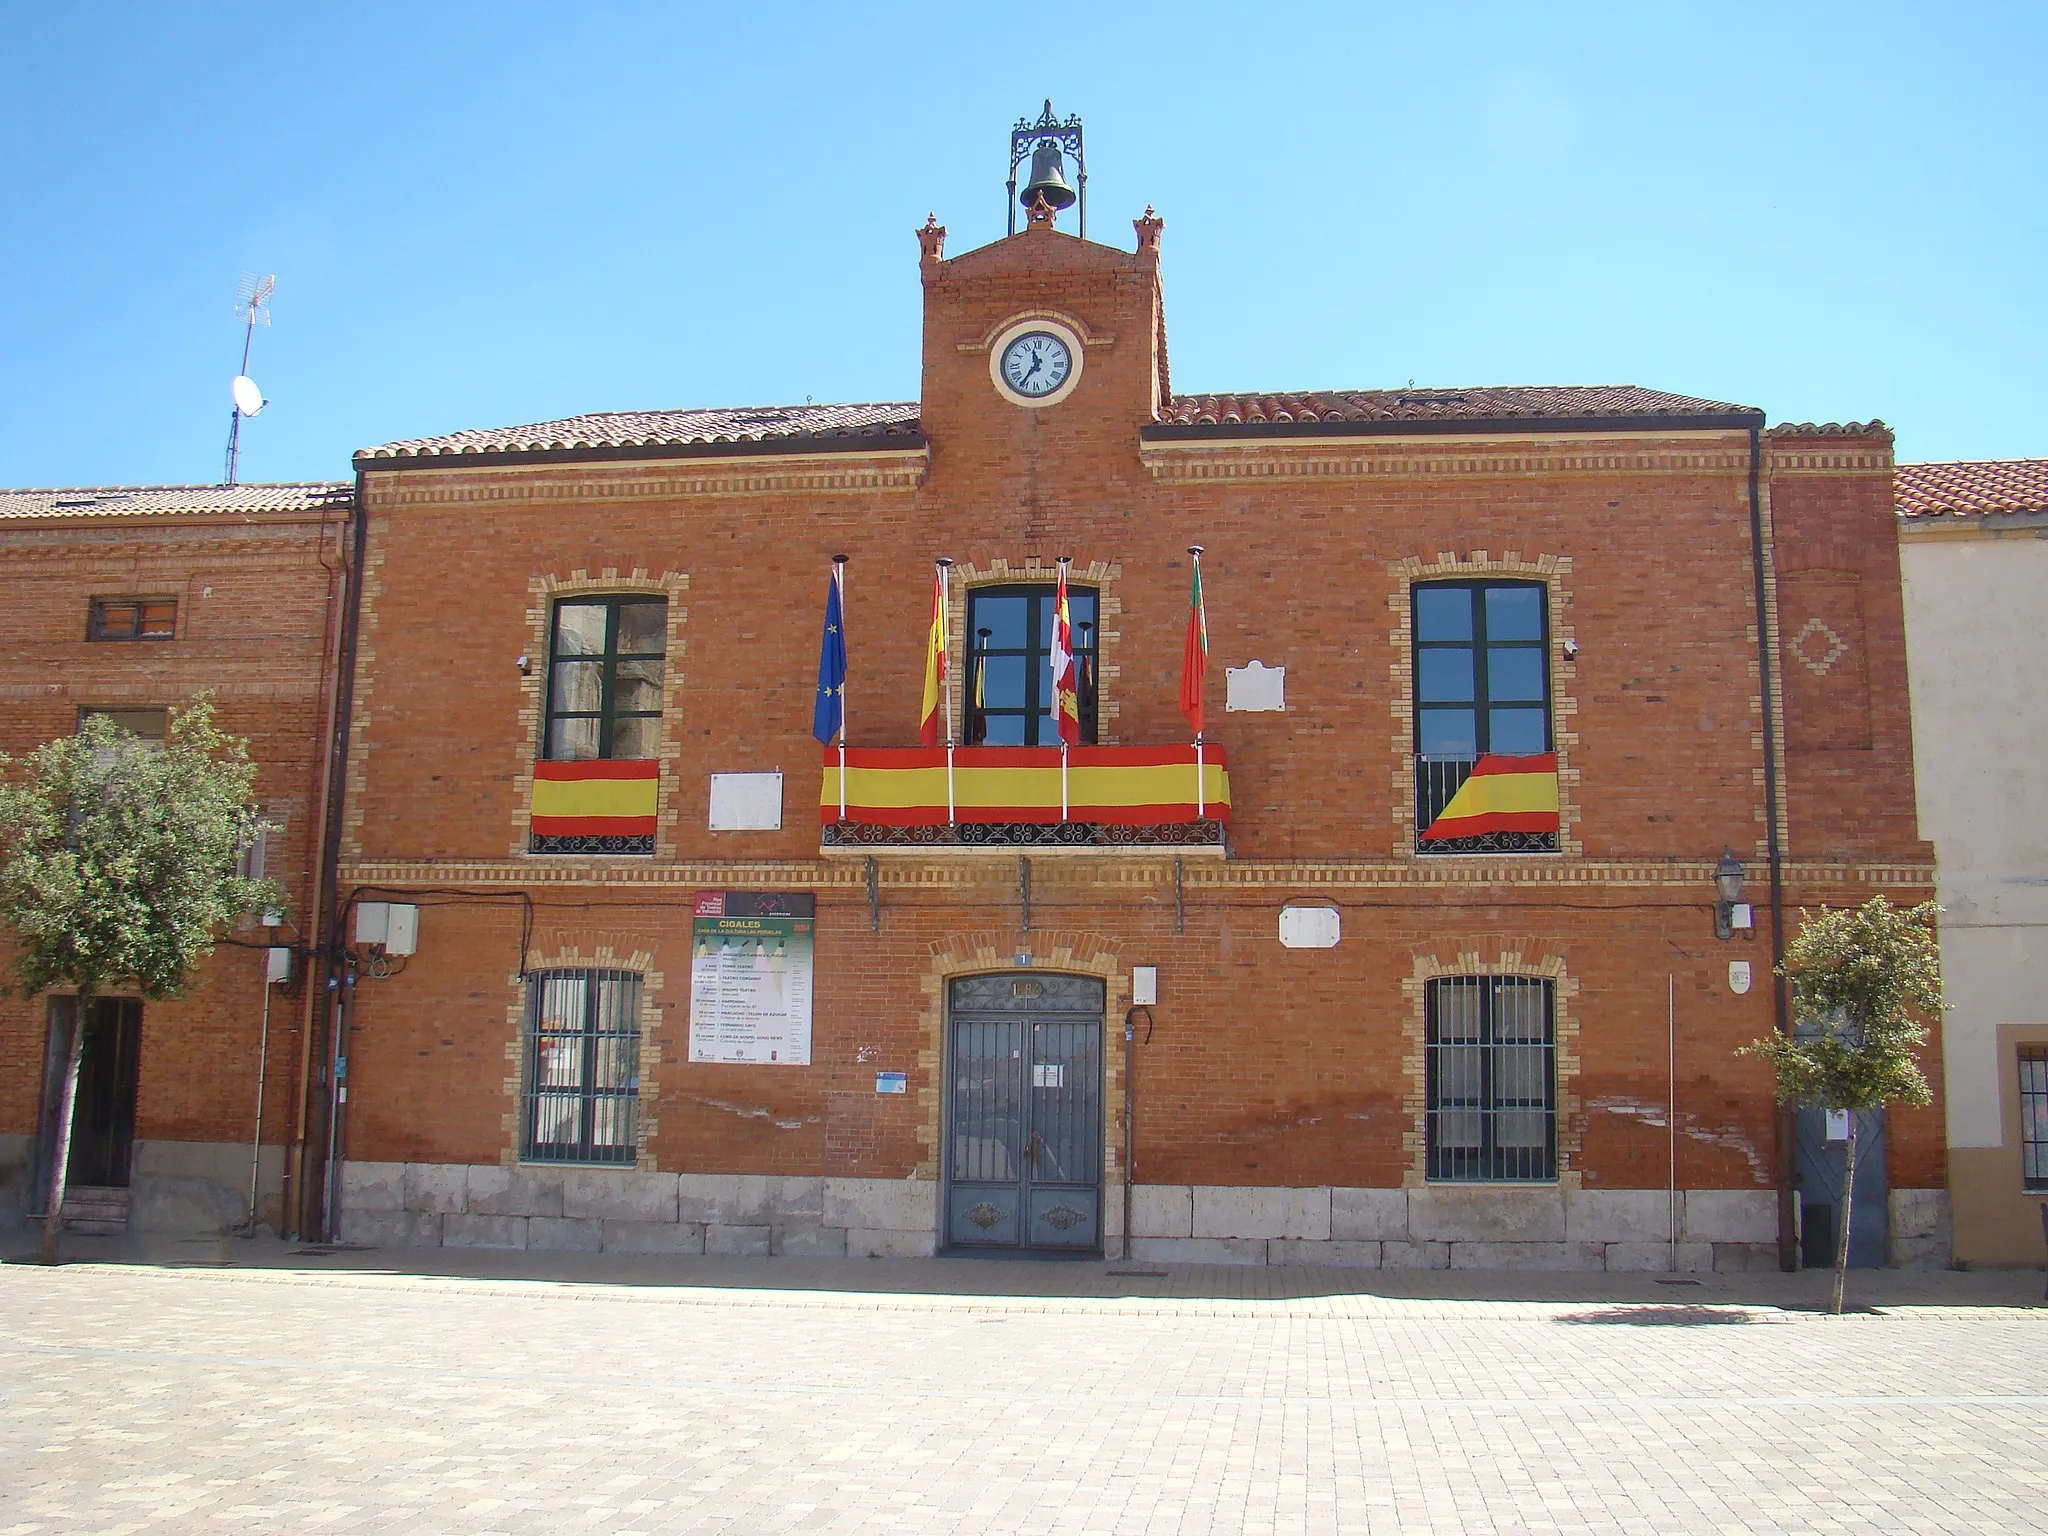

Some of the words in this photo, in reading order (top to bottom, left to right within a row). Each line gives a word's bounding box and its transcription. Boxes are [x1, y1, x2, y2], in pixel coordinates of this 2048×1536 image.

[1021, 343, 1031, 353] XI
[1033, 340, 1043, 350] XII
[719, 920, 761, 928] CIGALES
[1021, 954, 1026, 964] 1
